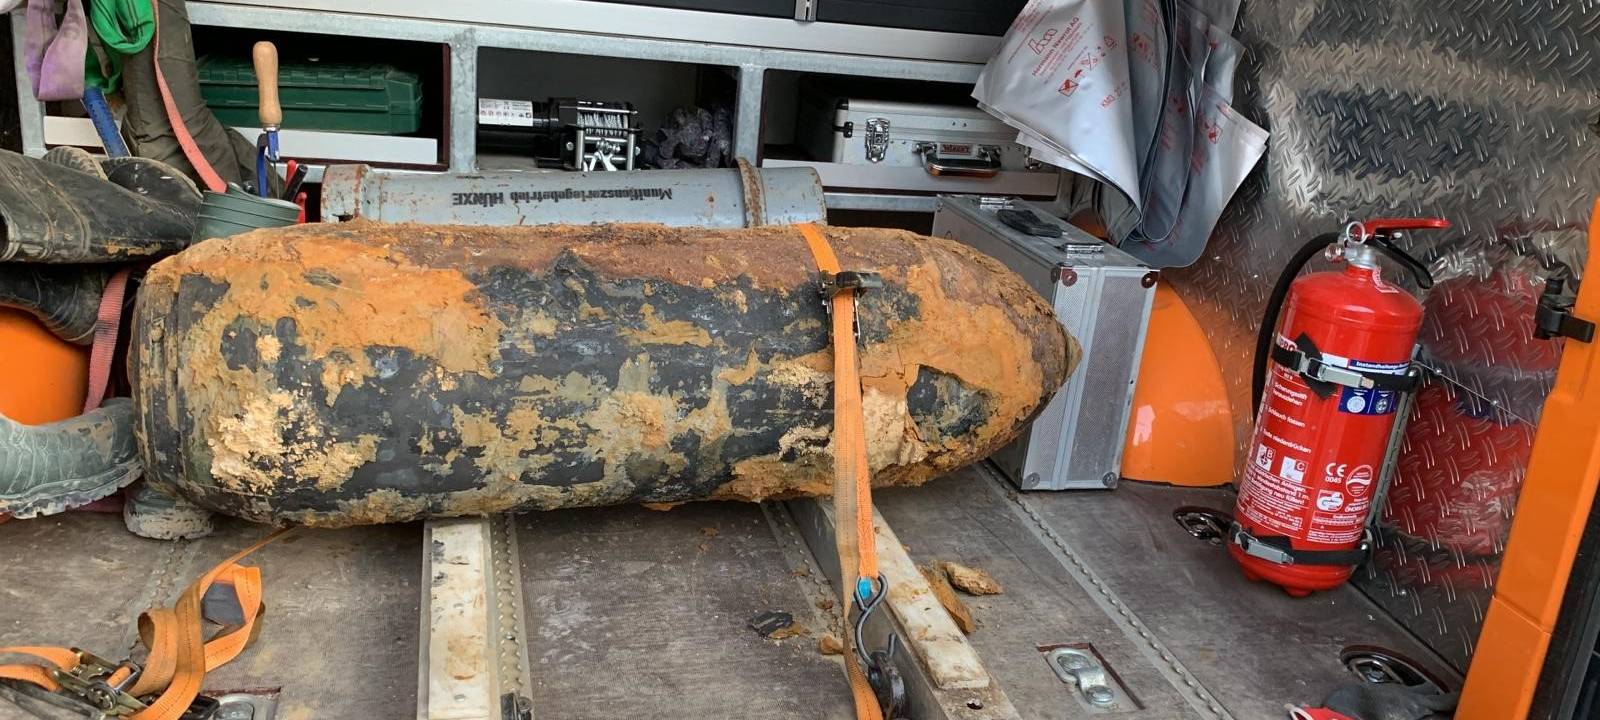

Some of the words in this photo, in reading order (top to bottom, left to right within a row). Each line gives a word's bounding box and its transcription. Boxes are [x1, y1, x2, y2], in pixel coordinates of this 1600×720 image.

[452, 191, 504, 206] HÜNXE
[1266, 448, 1274, 459] B
[1296, 461, 1305, 472] C
